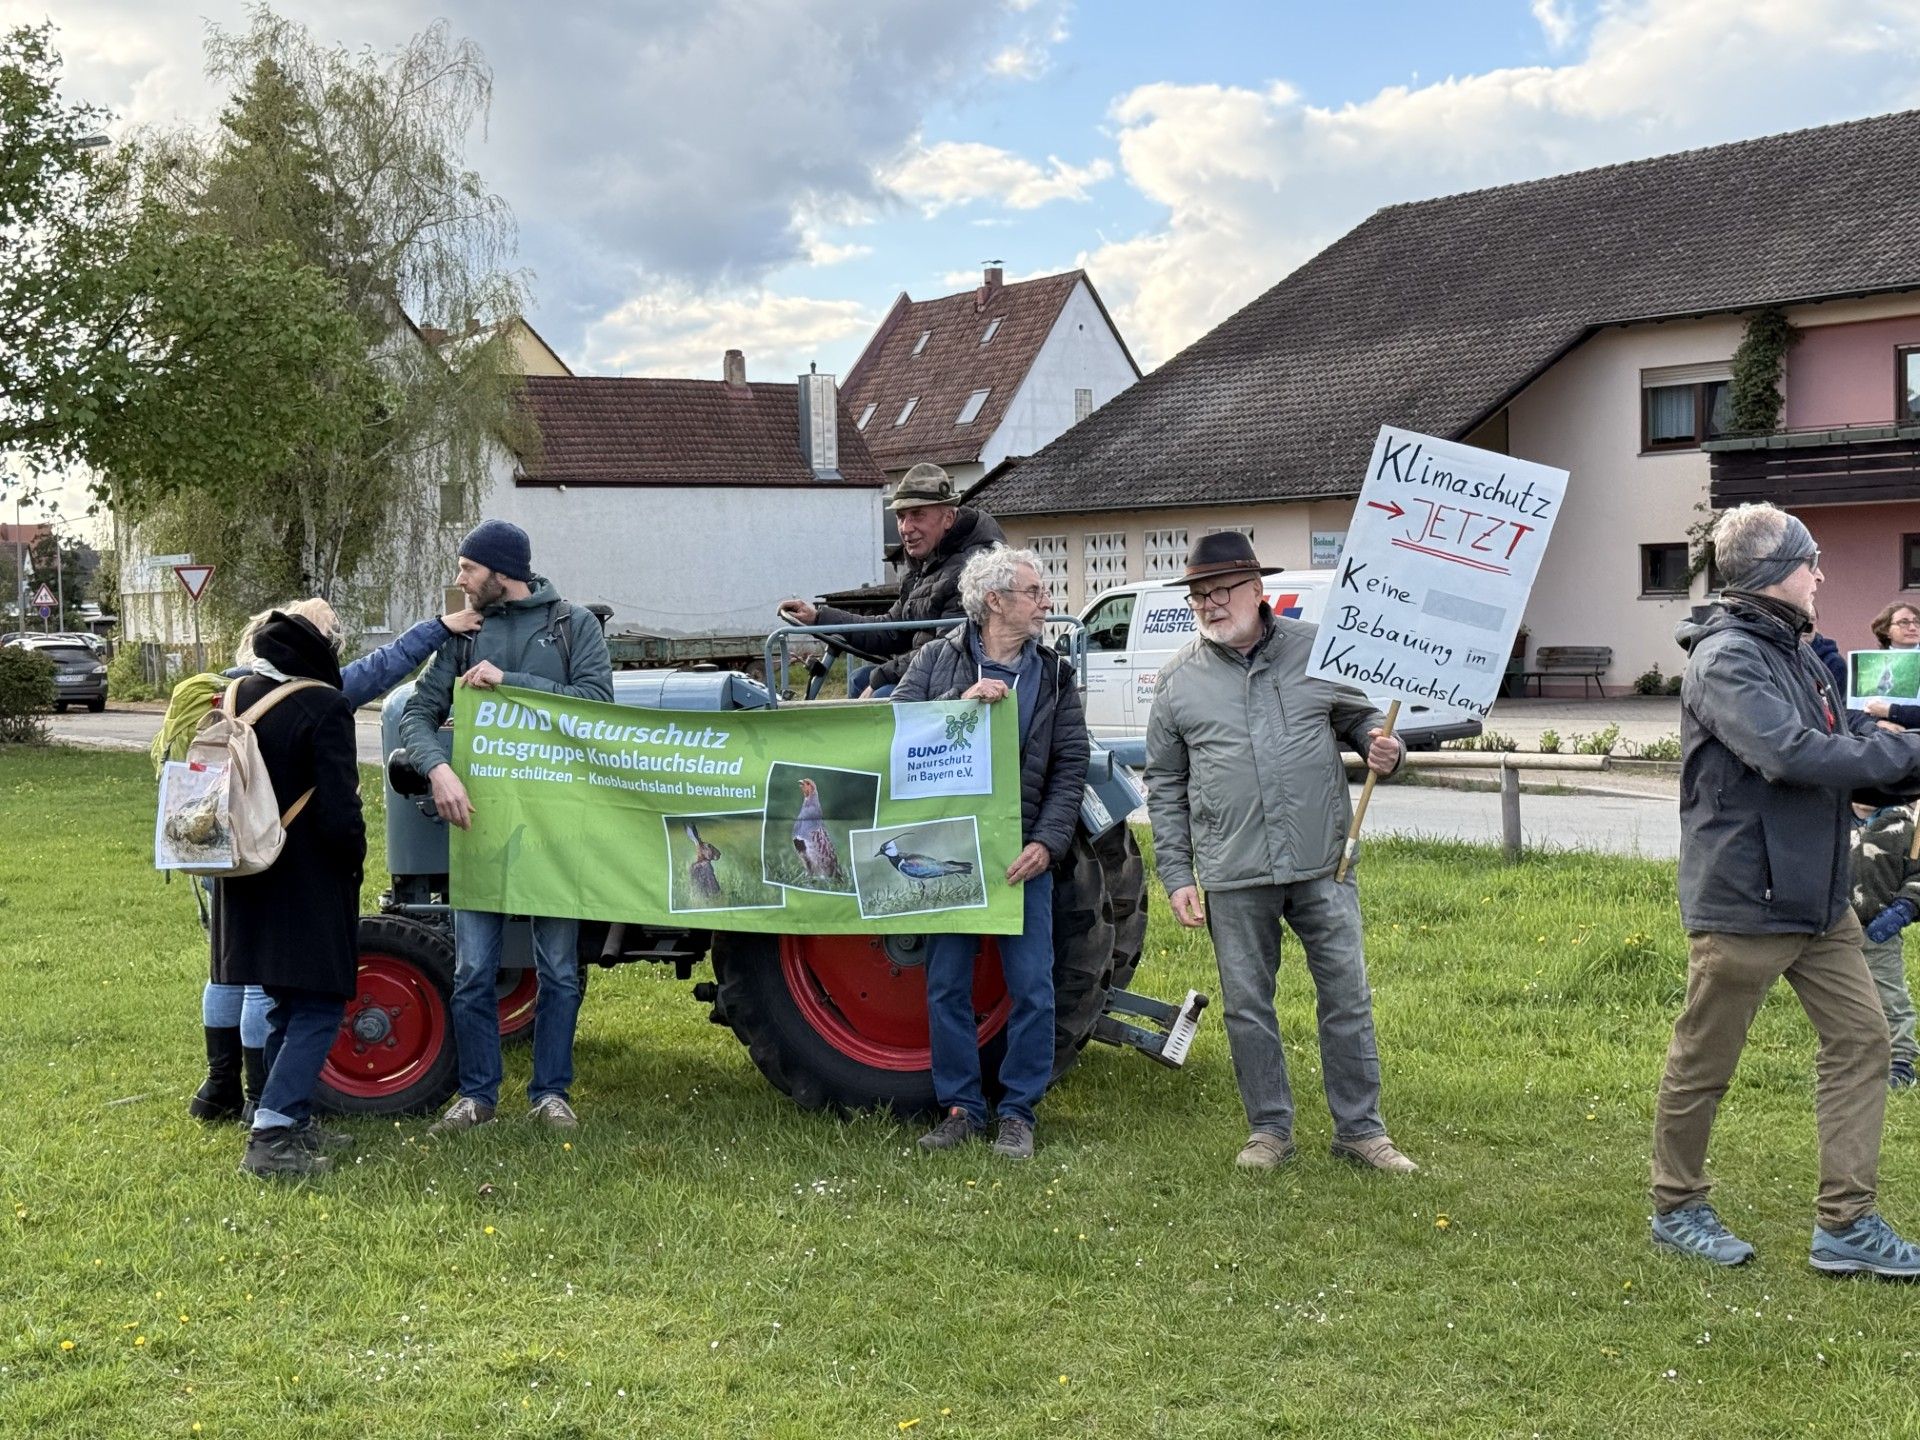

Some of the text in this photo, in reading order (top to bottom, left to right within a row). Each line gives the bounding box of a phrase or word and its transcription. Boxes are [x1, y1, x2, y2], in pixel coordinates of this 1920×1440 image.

[1376, 435, 1552, 519] Klimaschutz
[1405, 497, 1535, 560] JETZT
[1341, 557, 1417, 605] Keine
[1465, 649, 1487, 666] im
[475, 701, 730, 749] BUND Naturschutz
[472, 734, 744, 776] Ortsgruppe Knoblauchsland
[907, 745, 947, 758] BUND
[907, 755, 972, 771] Naturschutz
[470, 762, 508, 778] Natur
[510, 765, 574, 784] schützen
[588, 771, 684, 795] Knoblauchsland
[686, 782, 757, 799] bewahren!
[907, 767, 973, 783] in Bayern e.V.
